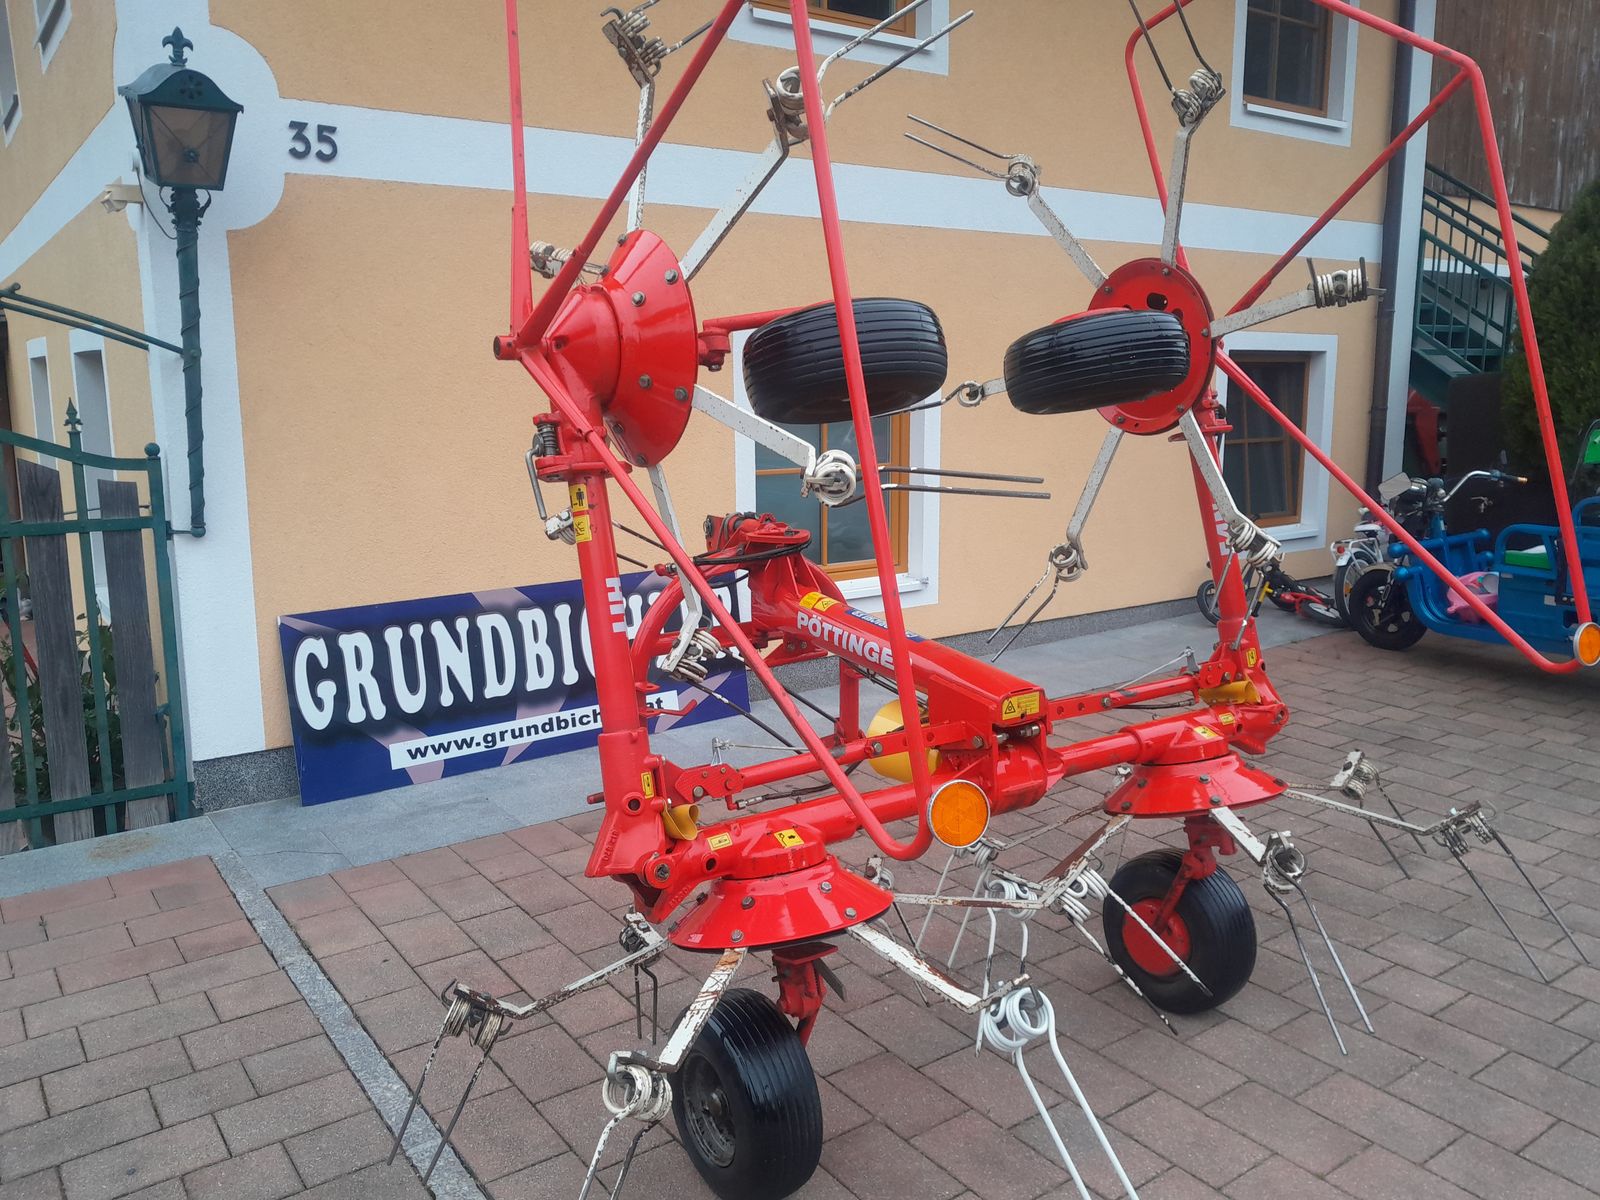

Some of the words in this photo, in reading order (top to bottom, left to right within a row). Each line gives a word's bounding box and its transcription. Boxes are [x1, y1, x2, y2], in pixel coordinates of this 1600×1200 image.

[288, 120, 338, 163] 35
[294, 586, 738, 731] GRUNDBI
[797, 609, 912, 671] PÖTTINGE
